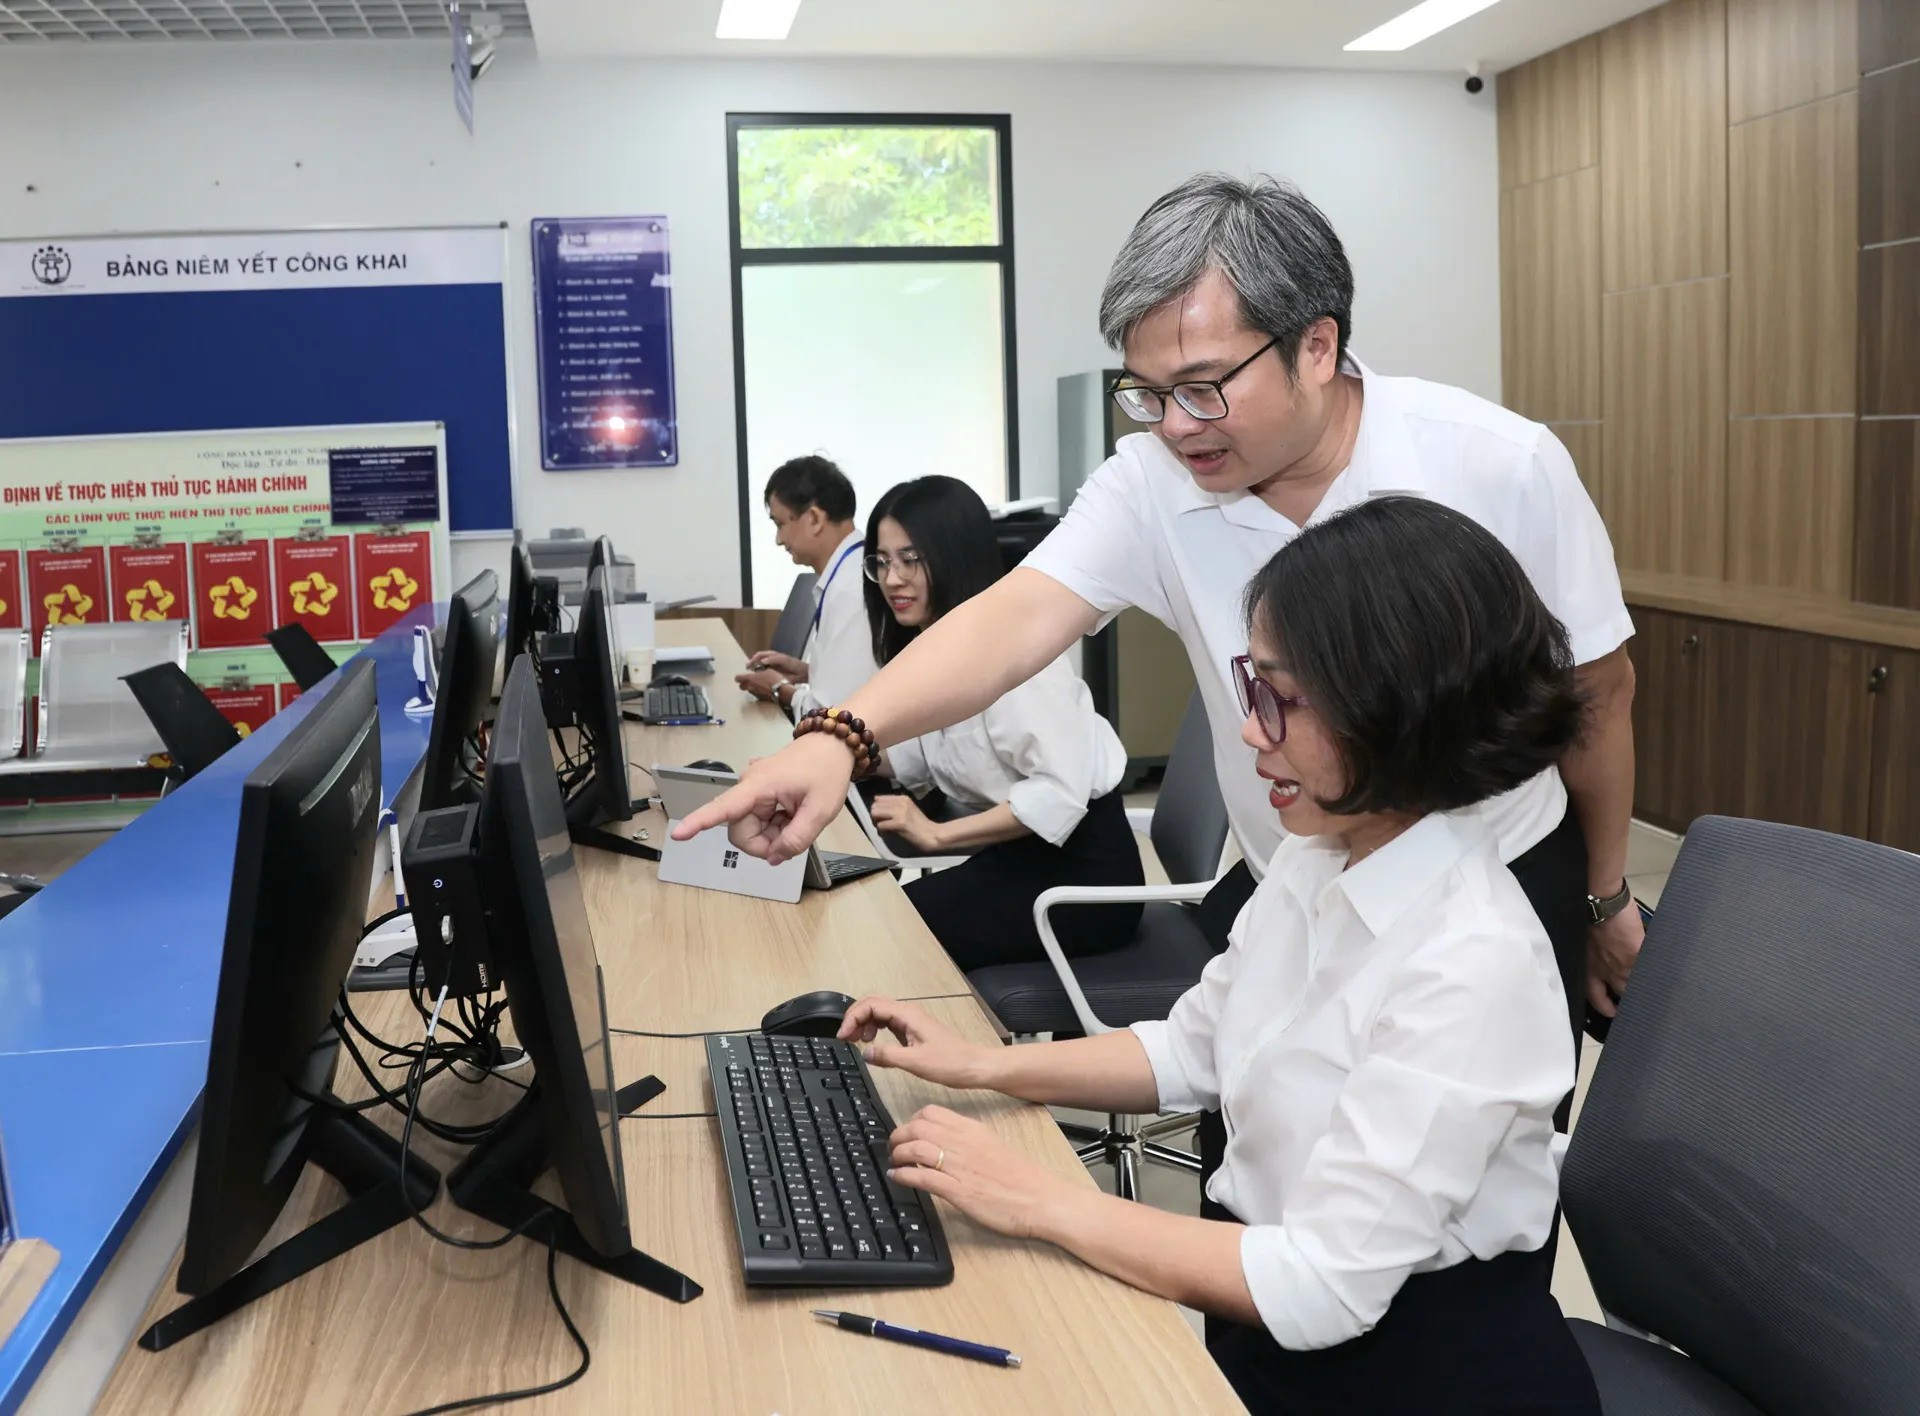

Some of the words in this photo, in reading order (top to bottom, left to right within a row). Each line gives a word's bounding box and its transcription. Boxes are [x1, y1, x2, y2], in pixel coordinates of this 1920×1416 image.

[107, 254, 169, 278] BẢNG
[177, 254, 229, 276] NIÊM
[237, 251, 278, 275] YẾT
[286, 252, 348, 272] CÔNG
[357, 253, 408, 270] KHAI
[3, 486, 41, 506] ĐỊNH
[45, 480, 63, 502] VỀ
[68, 482, 107, 503] THỰC
[111, 480, 147, 501] HIỆN
[151, 475, 179, 497] THỦ
[183, 478, 211, 499] TỤC
[216, 475, 257, 495] HÀNH
[261, 472, 307, 493] CHÍNH
[45, 512, 71, 525] CÁC
